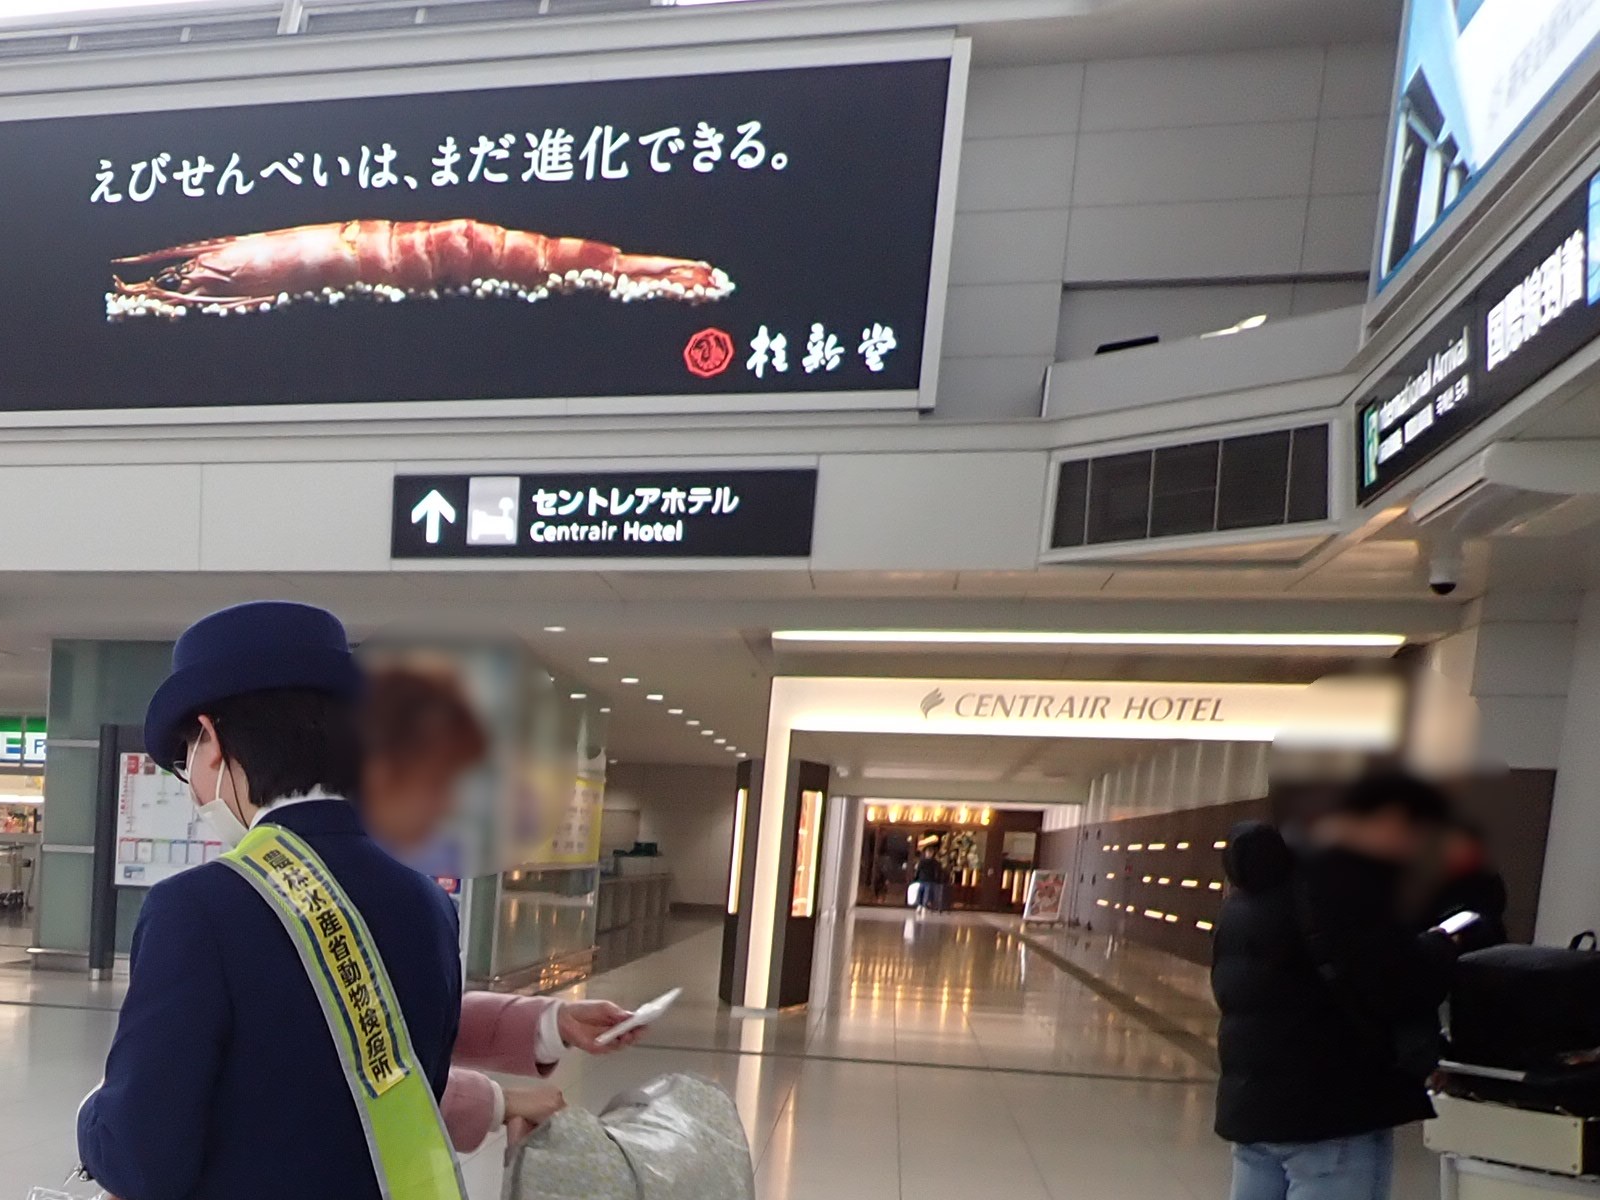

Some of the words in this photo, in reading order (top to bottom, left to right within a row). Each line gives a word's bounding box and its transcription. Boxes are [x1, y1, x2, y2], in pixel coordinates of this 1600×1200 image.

[89, 119, 789, 203] えびせんべいは、まだ進化できる。
[532, 486, 740, 517] セントレアホテル
[530, 521, 617, 542] Centrair
[623, 519, 683, 541] Hotel
[954, 692, 1111, 720] CENTRAIR
[1122, 695, 1226, 722] HOTEL
[263, 849, 393, 1083] 農林水産省動物検疫所
